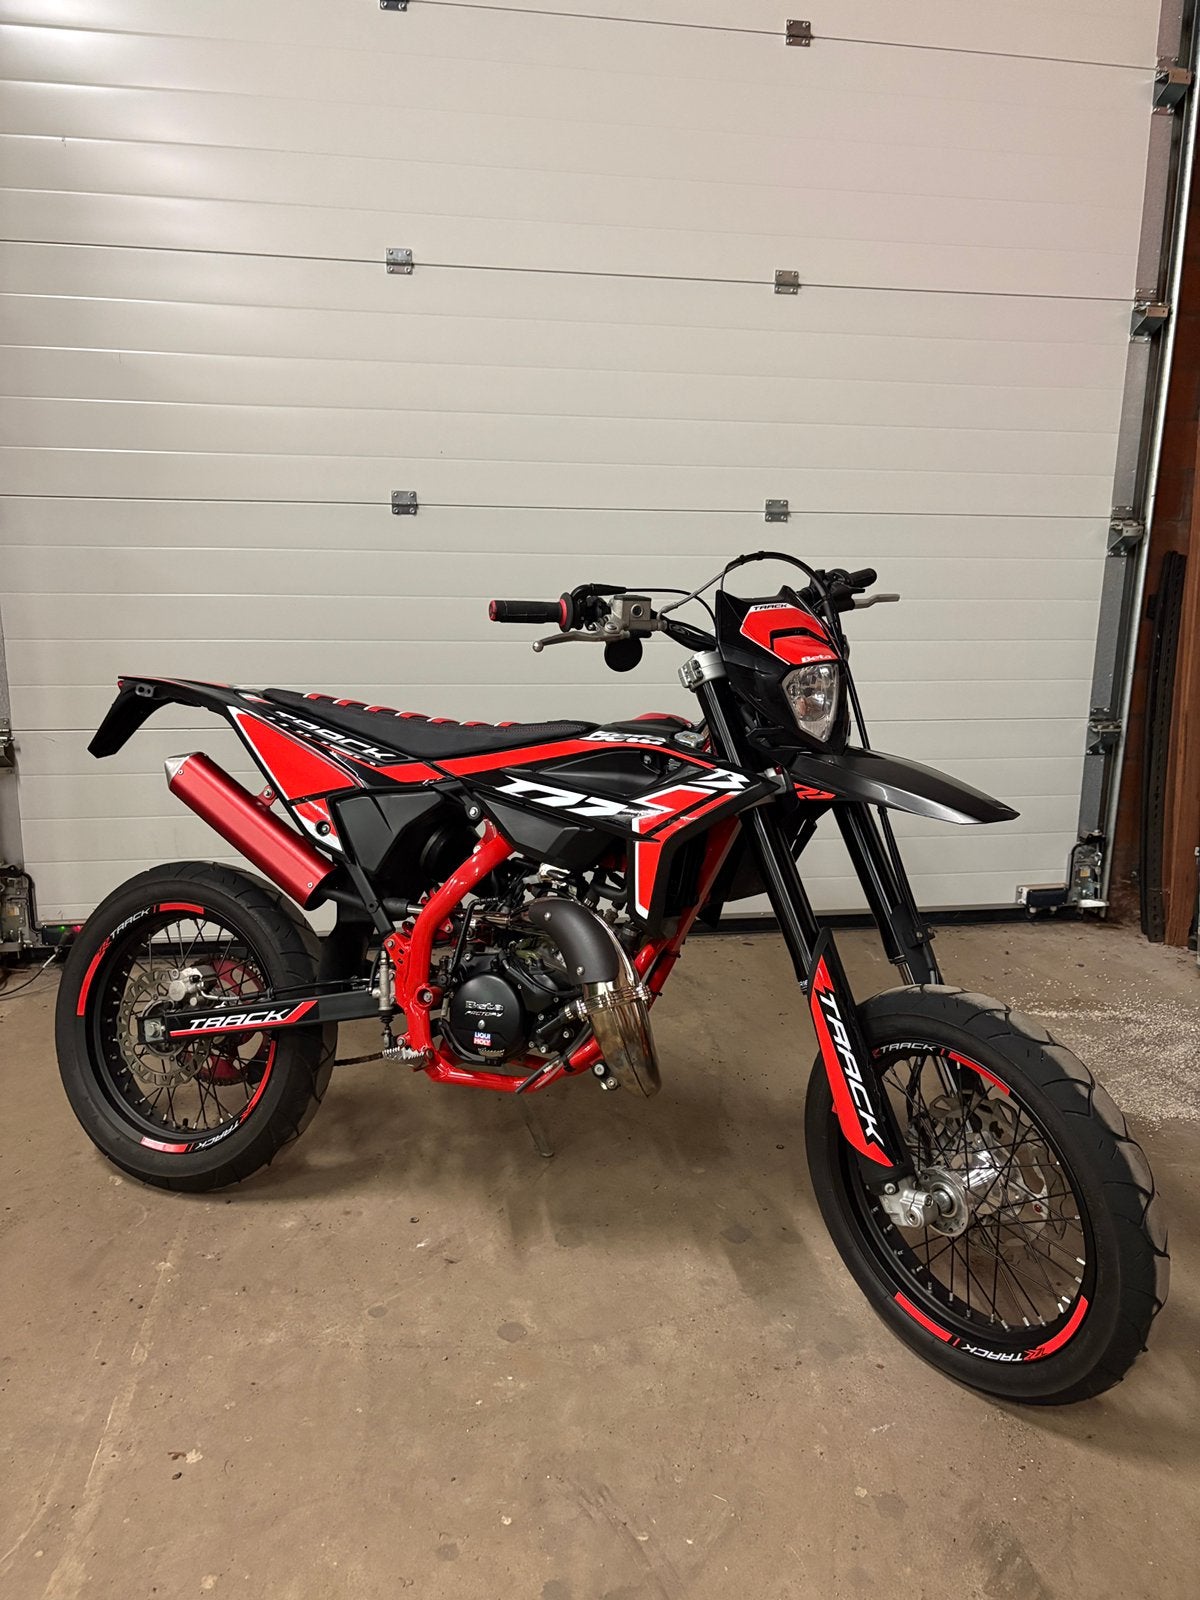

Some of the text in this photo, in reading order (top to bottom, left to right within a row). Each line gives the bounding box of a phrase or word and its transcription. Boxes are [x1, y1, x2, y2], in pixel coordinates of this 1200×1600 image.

[753, 603, 788, 611] TRACK
[801, 654, 832, 663] Beta
[275, 711, 397, 759] TRACK
[110, 907, 151, 939] TRACK
[465, 1000, 504, 1011] Beta
[190, 1008, 291, 1030] TRACK
[880, 1042, 937, 1054] TRACK
[820, 993, 886, 1147] TRACK
[960, 1343, 1023, 1362] TRACK
